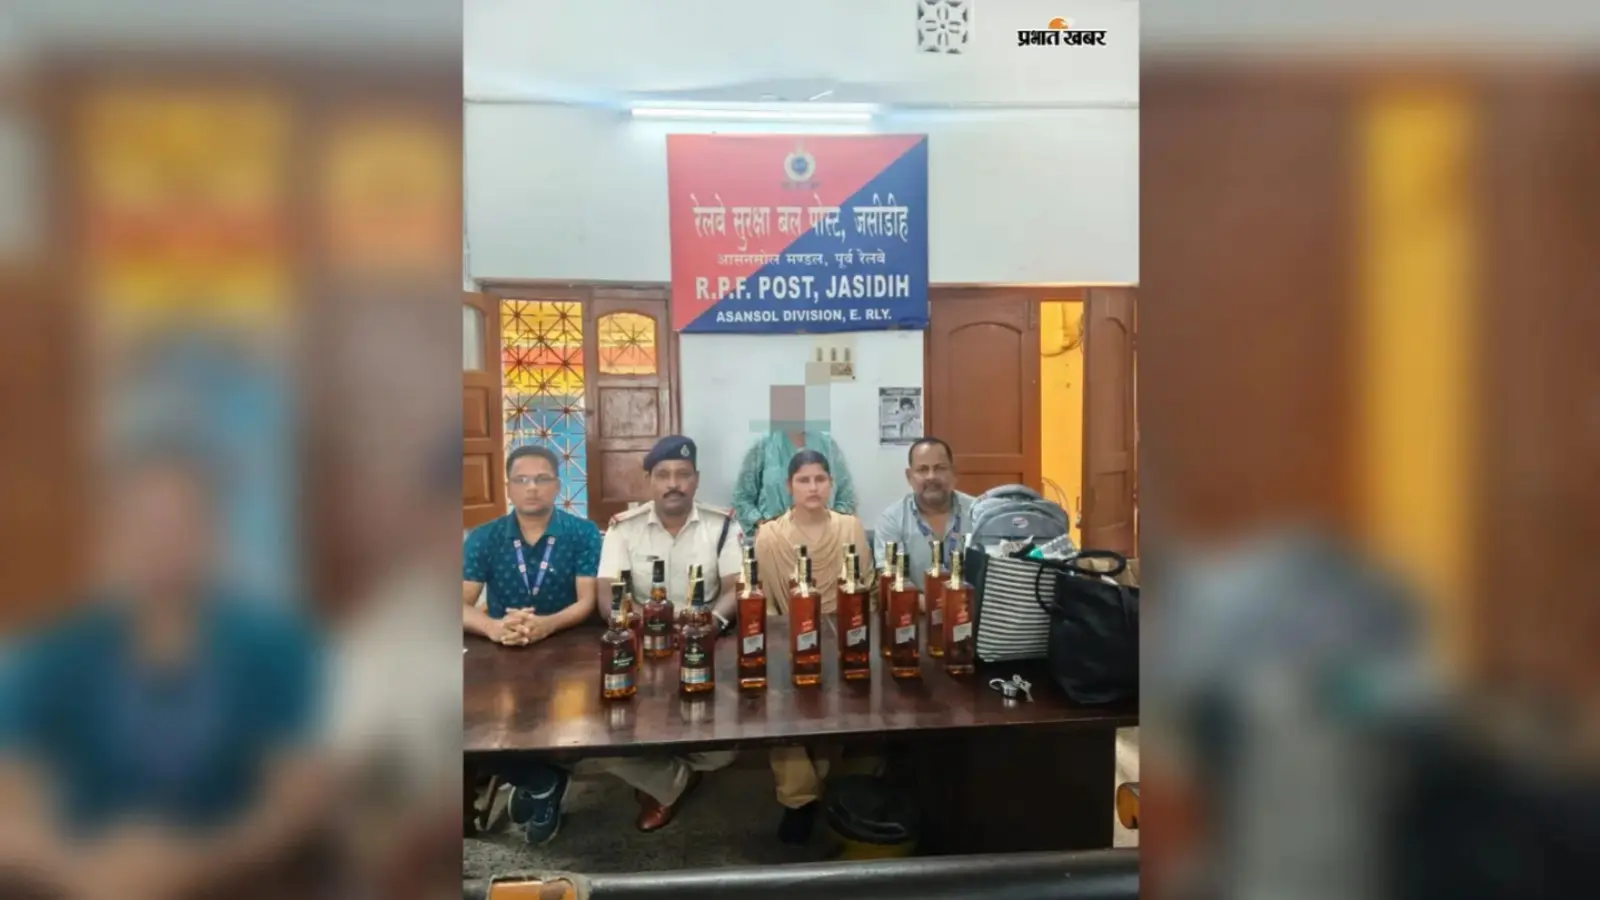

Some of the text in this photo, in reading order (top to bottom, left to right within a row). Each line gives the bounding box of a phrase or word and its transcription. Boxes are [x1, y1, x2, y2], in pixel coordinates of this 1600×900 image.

[690, 192, 909, 251] रेलवे सुरक्षा बल पोस्ट, जसीडीह
[717, 248, 886, 269] आसनसोल मण्डल, पूर्व रेलवे
[695, 274, 910, 303] R.P.F. POST, JASIDIH
[716, 309, 892, 323] ASANSOL DIVISION, E. RLY.
